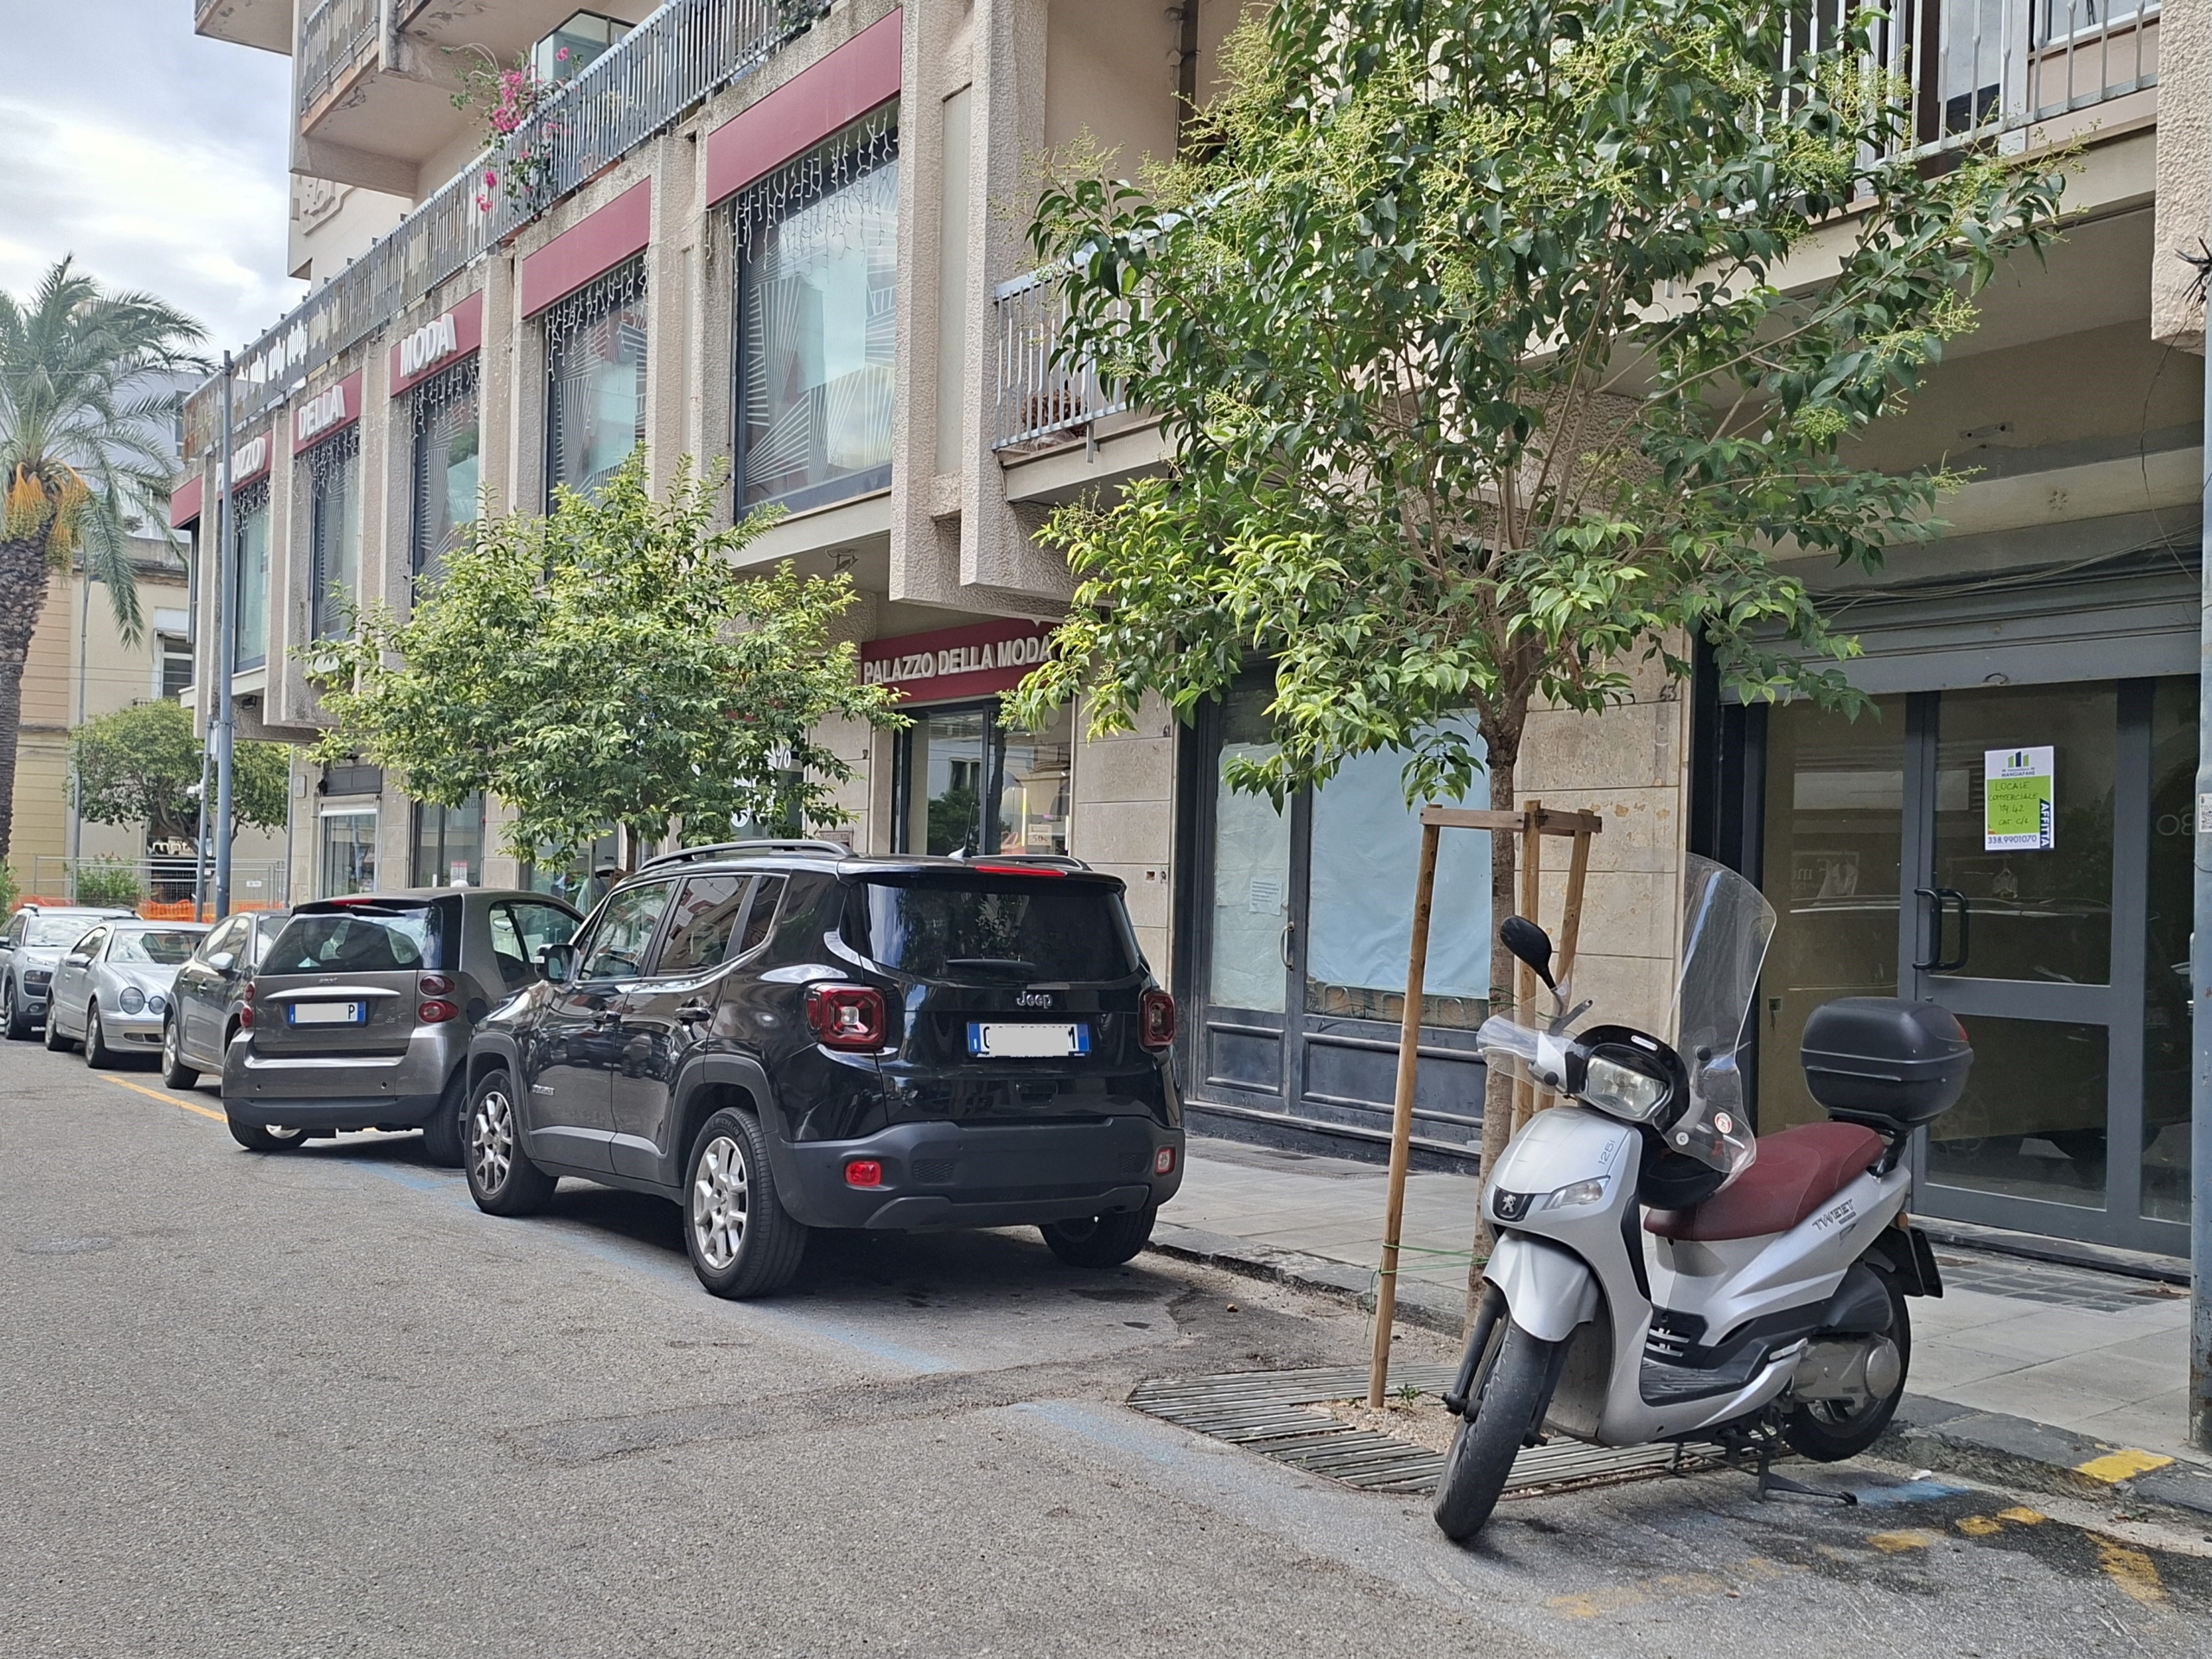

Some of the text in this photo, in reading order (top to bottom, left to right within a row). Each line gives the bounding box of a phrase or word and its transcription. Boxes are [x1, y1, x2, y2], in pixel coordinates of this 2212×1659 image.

[399, 313, 457, 378] MODA
[298, 385, 346, 442] DELLA
[216, 436, 265, 492] PAZZO
[864, 635, 1054, 685] PALAZZO DELLA MODA
[1659, 684, 1677, 702] 63
[1995, 781, 2031, 791] LOCALE
[1987, 835, 2037, 844] 338.9901070
[2041, 803, 2050, 847] AFFITTA
[1016, 991, 1053, 1009] Jeep
[1811, 1198, 1854, 1230] TWEET
